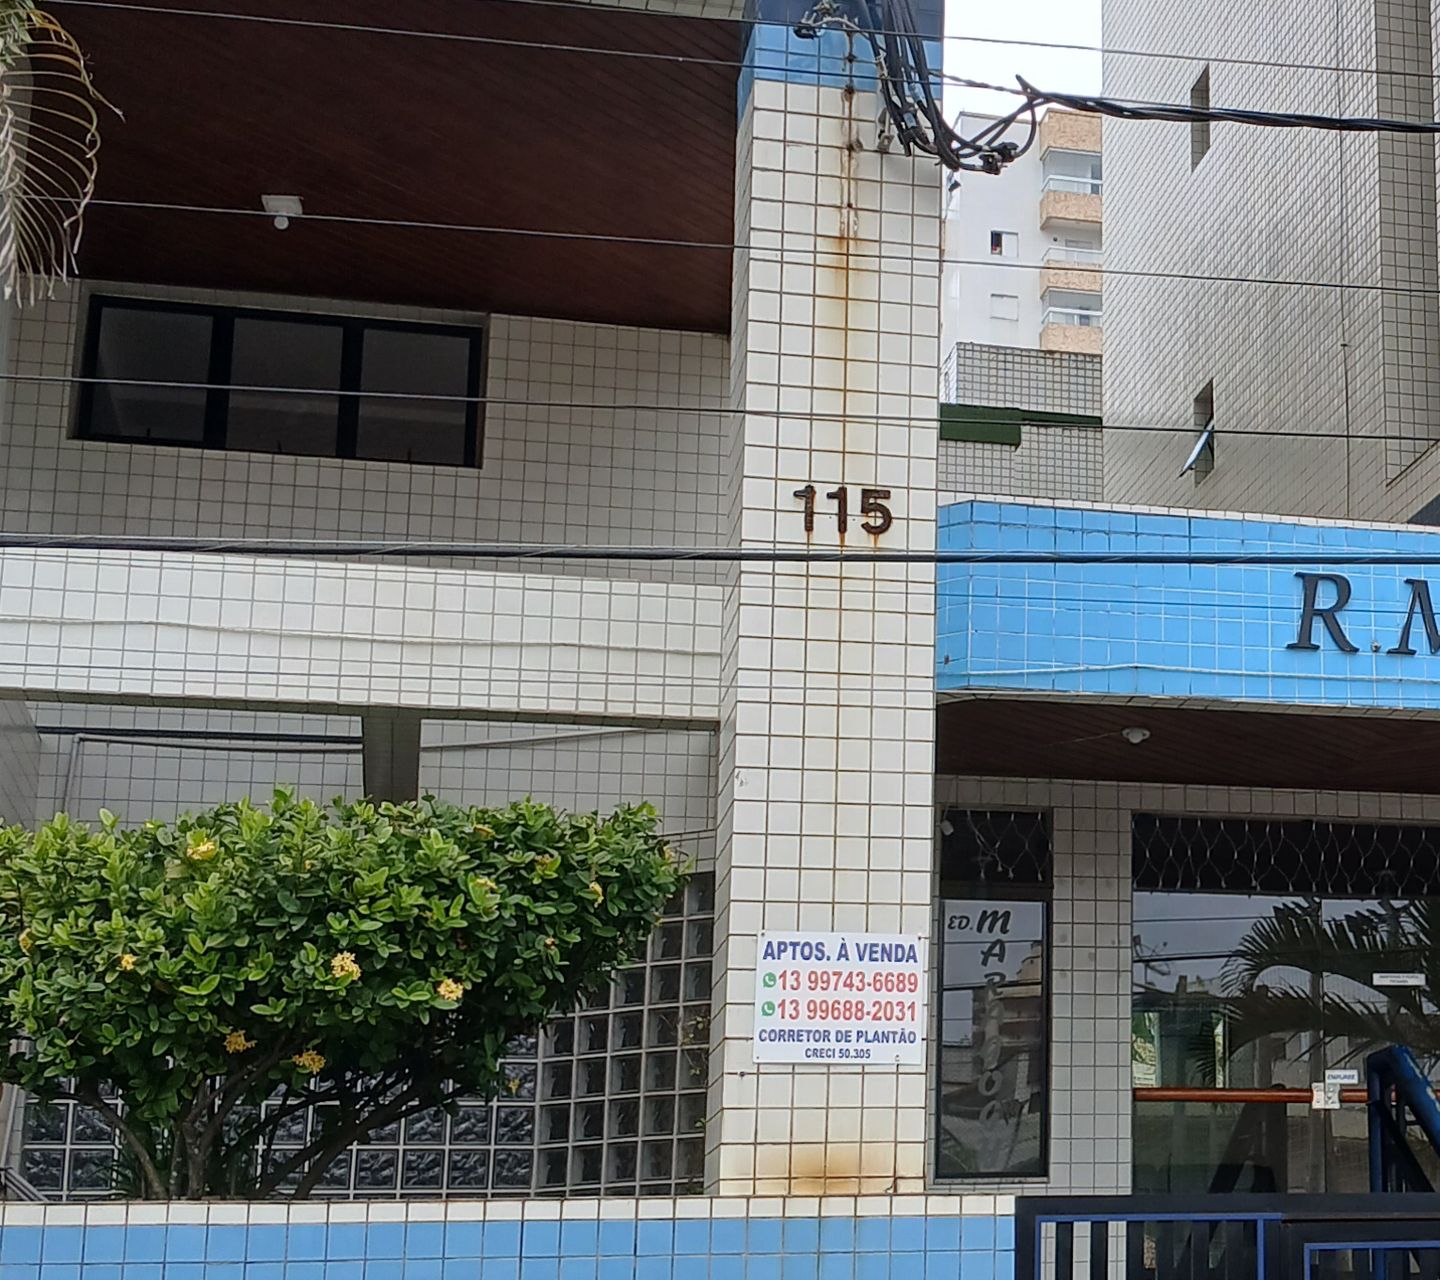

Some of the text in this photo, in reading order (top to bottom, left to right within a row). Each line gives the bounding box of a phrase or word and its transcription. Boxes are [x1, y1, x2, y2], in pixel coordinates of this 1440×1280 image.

[793, 484, 893, 535] 115
[762, 937, 918, 963] APTOS. À VENDA
[778, 969, 918, 993] 13 99743-6689
[777, 998, 916, 1021] 13 99688-2031
[758, 1028, 917, 1044] CORRETOR DE PLANTÃO
[805, 1048, 836, 1059] CRECI
